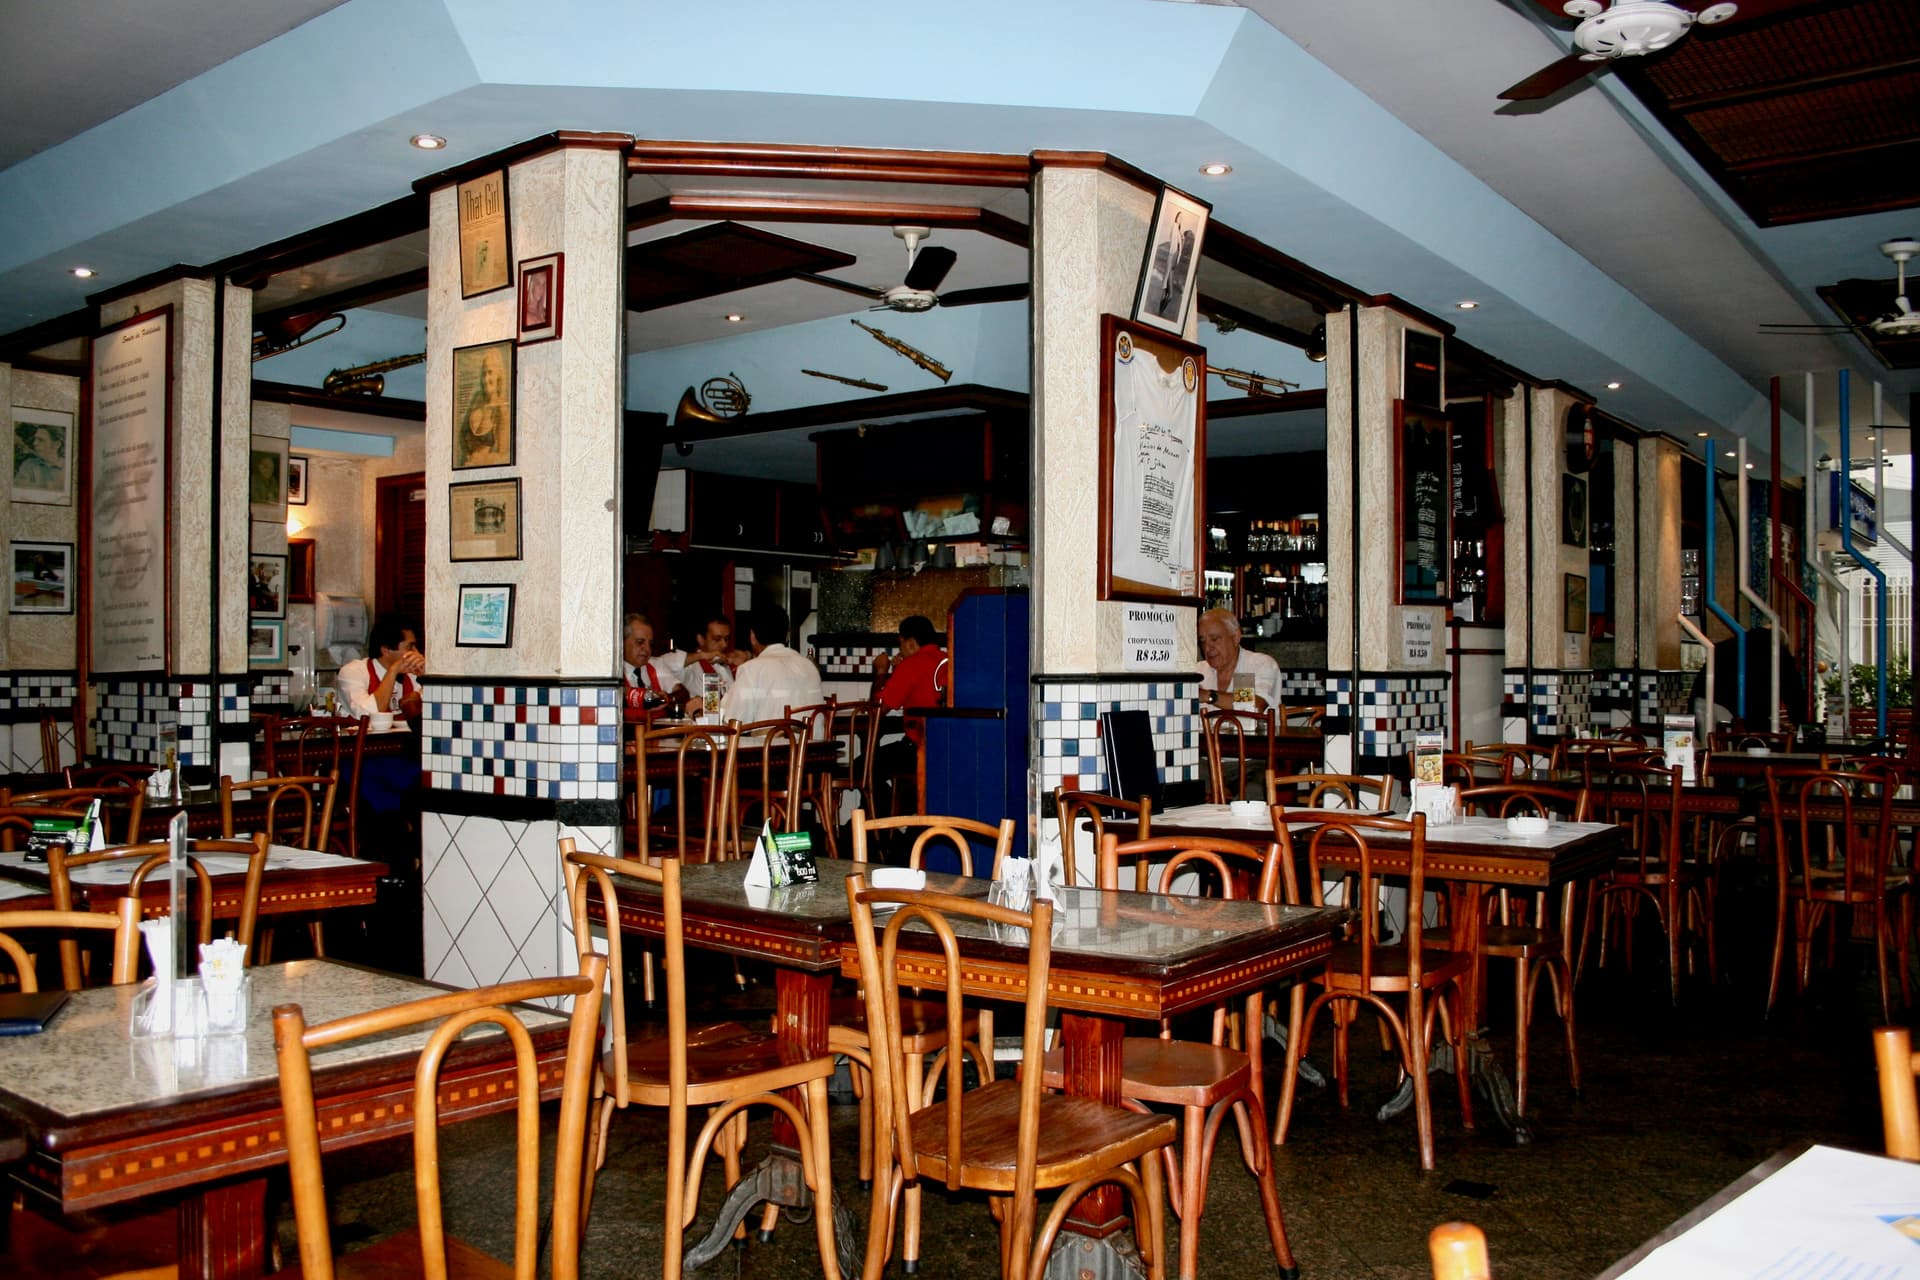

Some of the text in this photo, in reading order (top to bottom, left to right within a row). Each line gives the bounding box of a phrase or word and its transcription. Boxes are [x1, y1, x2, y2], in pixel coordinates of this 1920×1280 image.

[464, 181, 500, 222] That Girl
[1129, 610, 1174, 625] PROMOÇÃO
[1136, 649, 1170, 663] R$ 3,50
